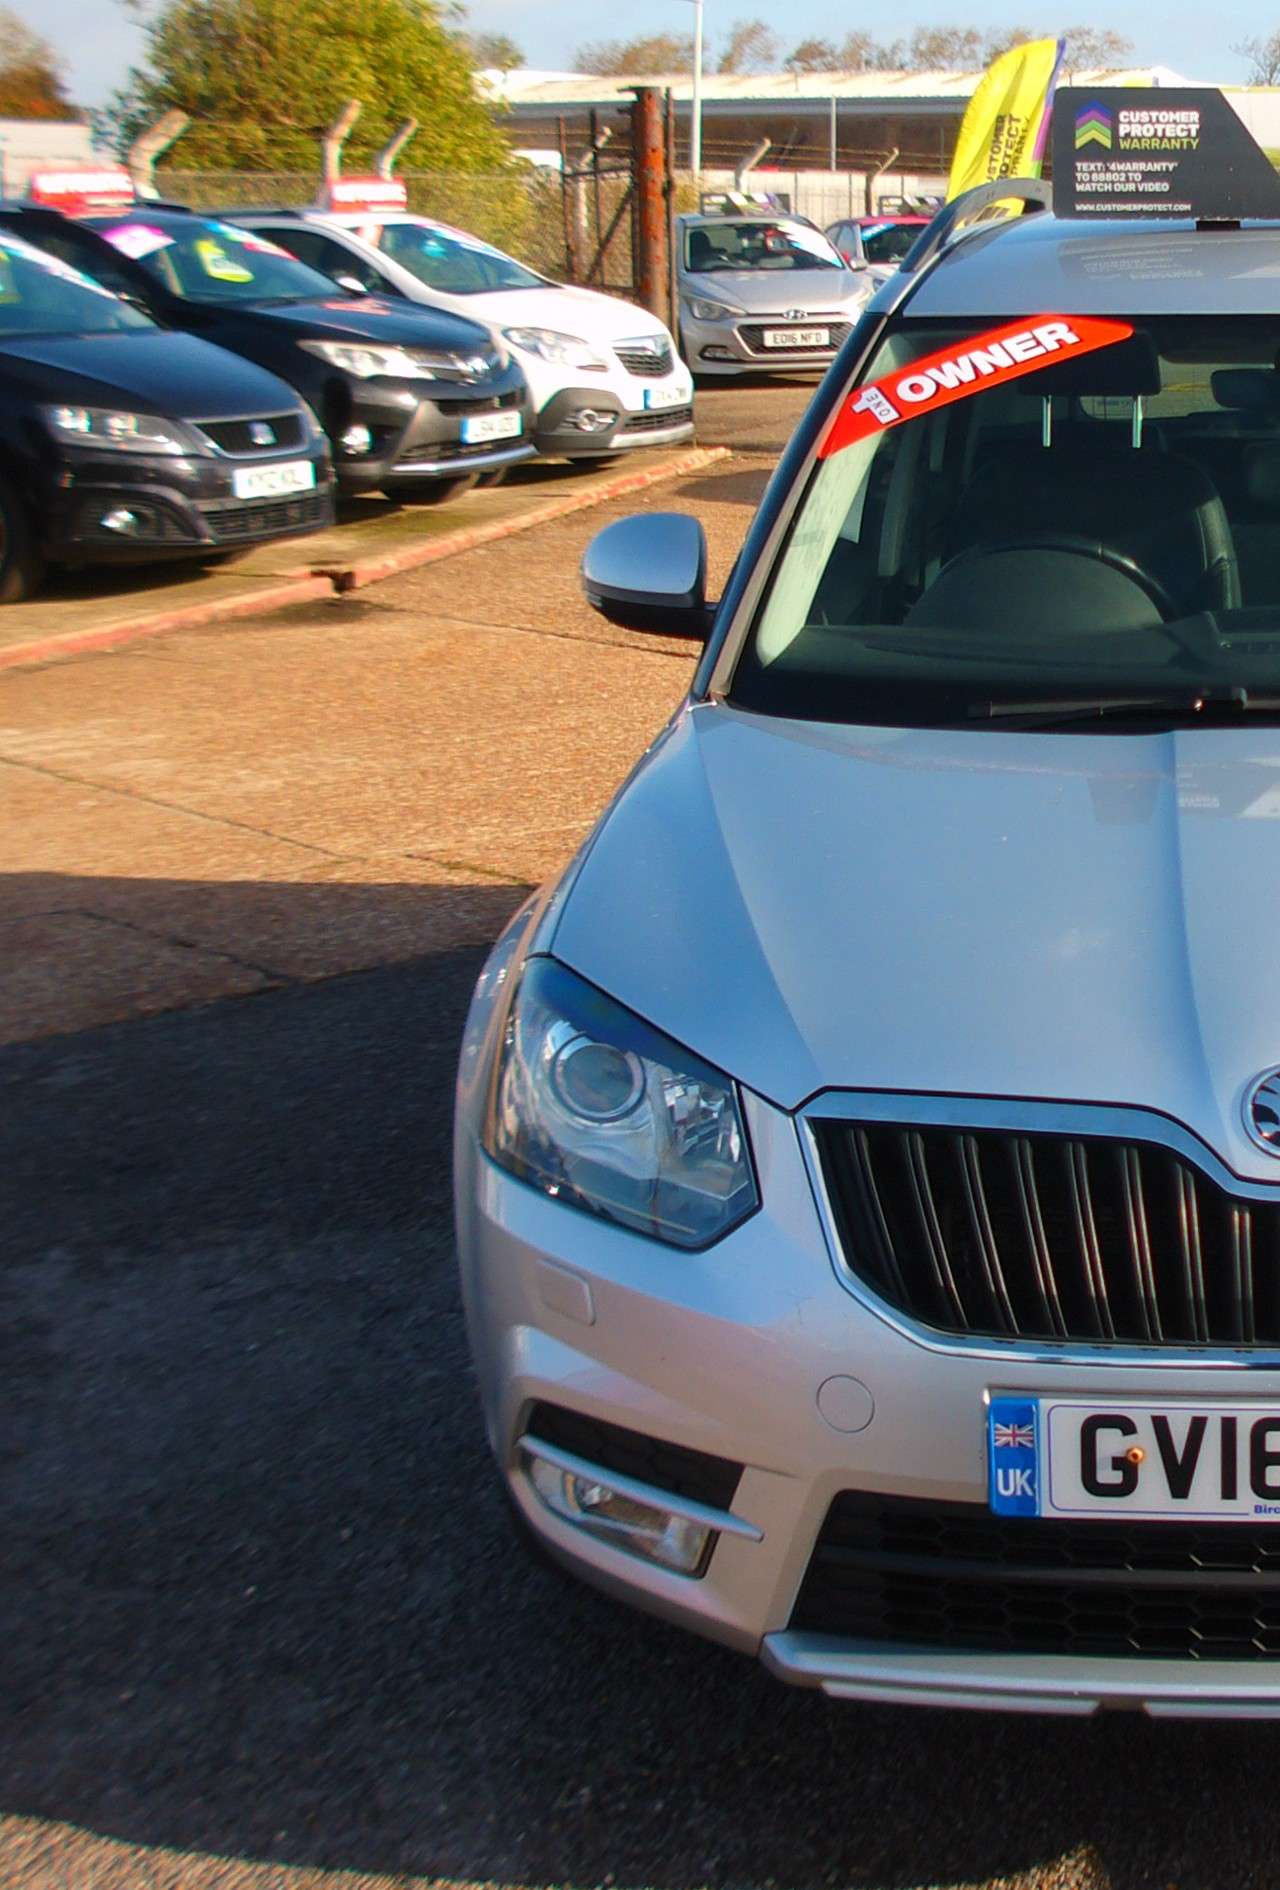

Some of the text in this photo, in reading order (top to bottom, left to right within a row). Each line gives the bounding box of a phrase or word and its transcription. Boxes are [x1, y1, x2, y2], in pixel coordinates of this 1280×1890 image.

[1119, 110, 1200, 123] CUSTOMER
[1119, 124, 1200, 137] PROTECT
[1119, 138, 1200, 150] WARRANTY
[1075, 162, 1105, 172] TEXT:
[1075, 172, 1090, 181] TO
[1127, 172, 1142, 181] TO
[1075, 182, 1170, 192] WATCH OUR VIDEO
[896, 321, 1081, 403] OWNER
[997, 1468, 1035, 1497] UK
